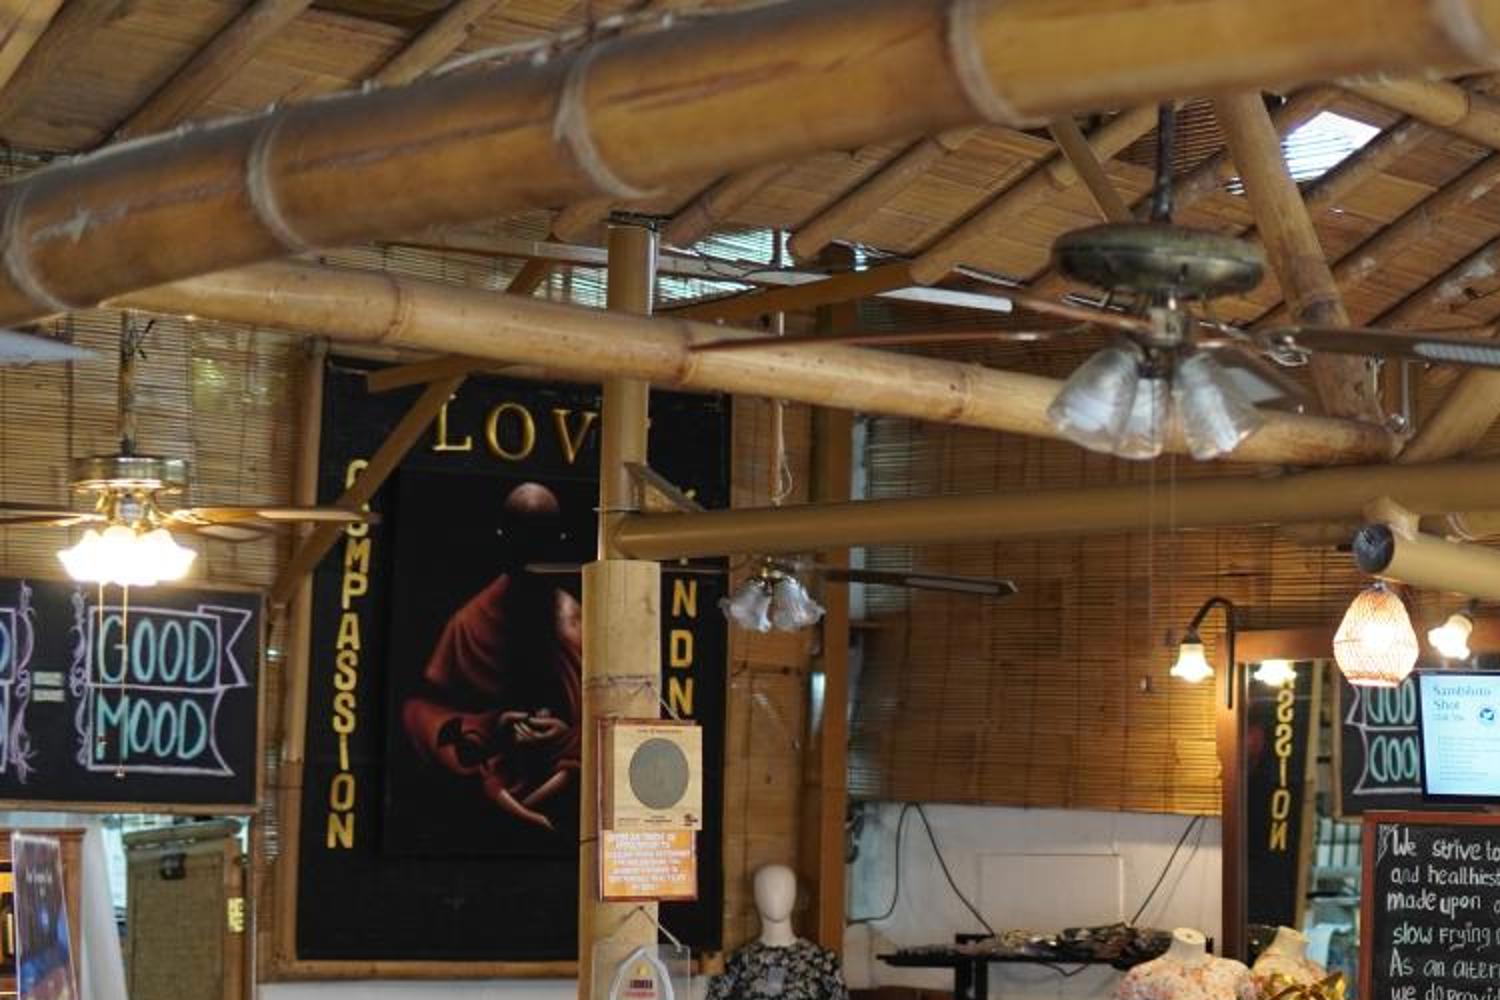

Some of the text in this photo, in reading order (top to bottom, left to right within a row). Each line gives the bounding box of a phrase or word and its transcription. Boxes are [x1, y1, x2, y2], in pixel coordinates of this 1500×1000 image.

[433, 395, 602, 464] LOV
[98, 613, 215, 684] GOOD
[326, 459, 371, 849] CMPASSION
[96, 693, 208, 760] MOOD
[1387, 887, 1437, 912] made
[1439, 894, 1481, 921] upon
